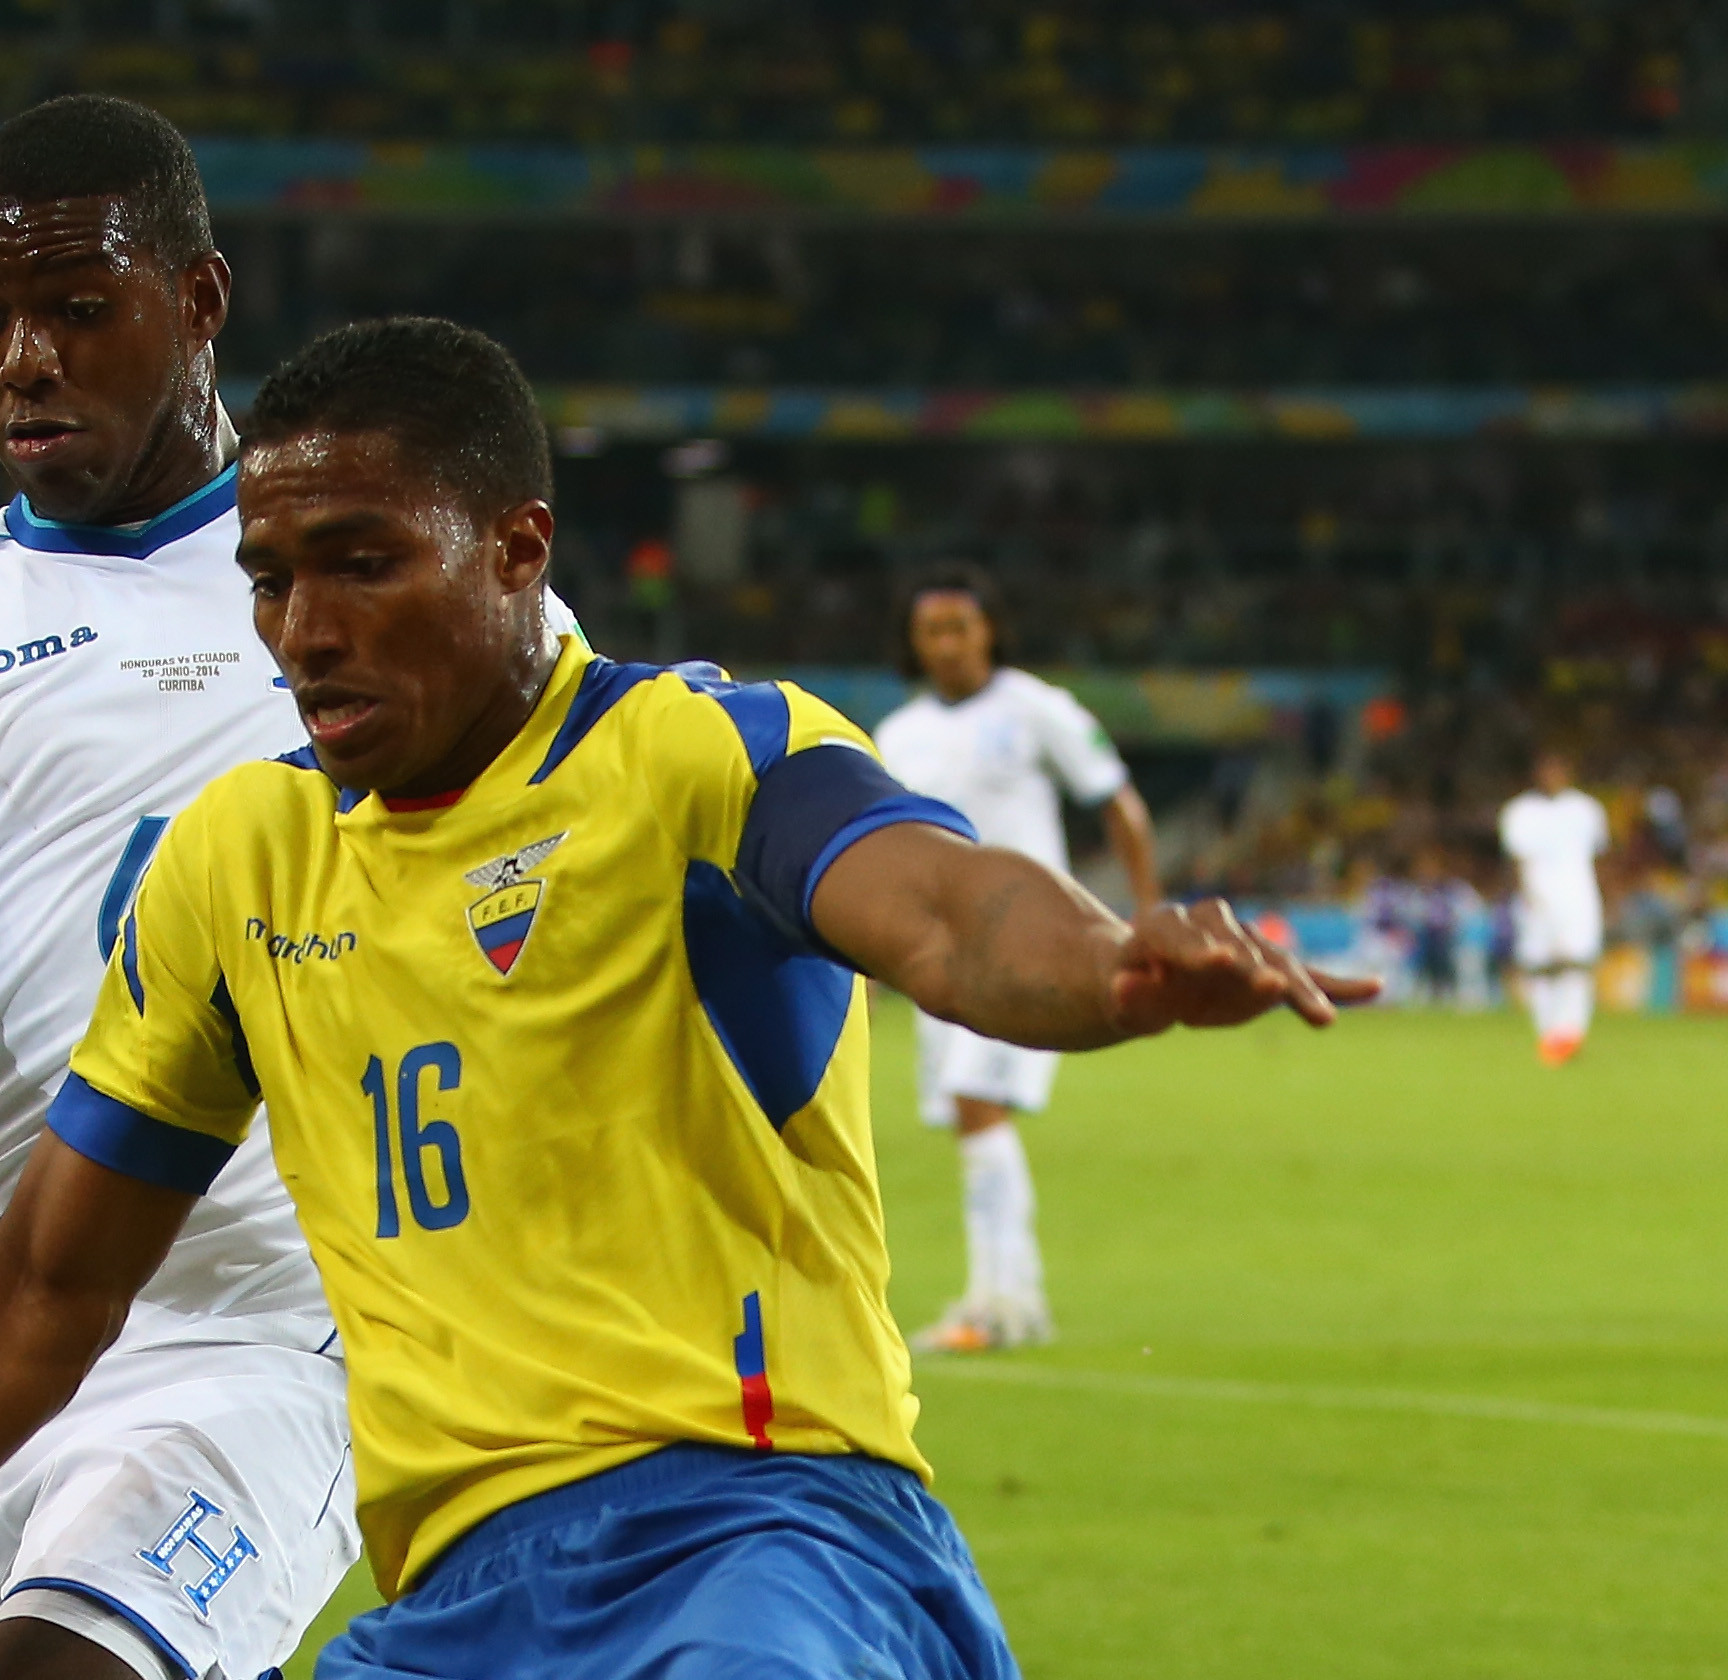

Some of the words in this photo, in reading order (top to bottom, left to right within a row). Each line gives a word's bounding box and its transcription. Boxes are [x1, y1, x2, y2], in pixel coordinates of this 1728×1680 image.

[120, 657, 175, 670] HONDURAS
[193, 652, 241, 664] ECUADOR
[142, 666, 220, 678] 20-JUNIO-2014
[158, 678, 205, 692] CURITIBA
[361, 1041, 470, 1238] 16
